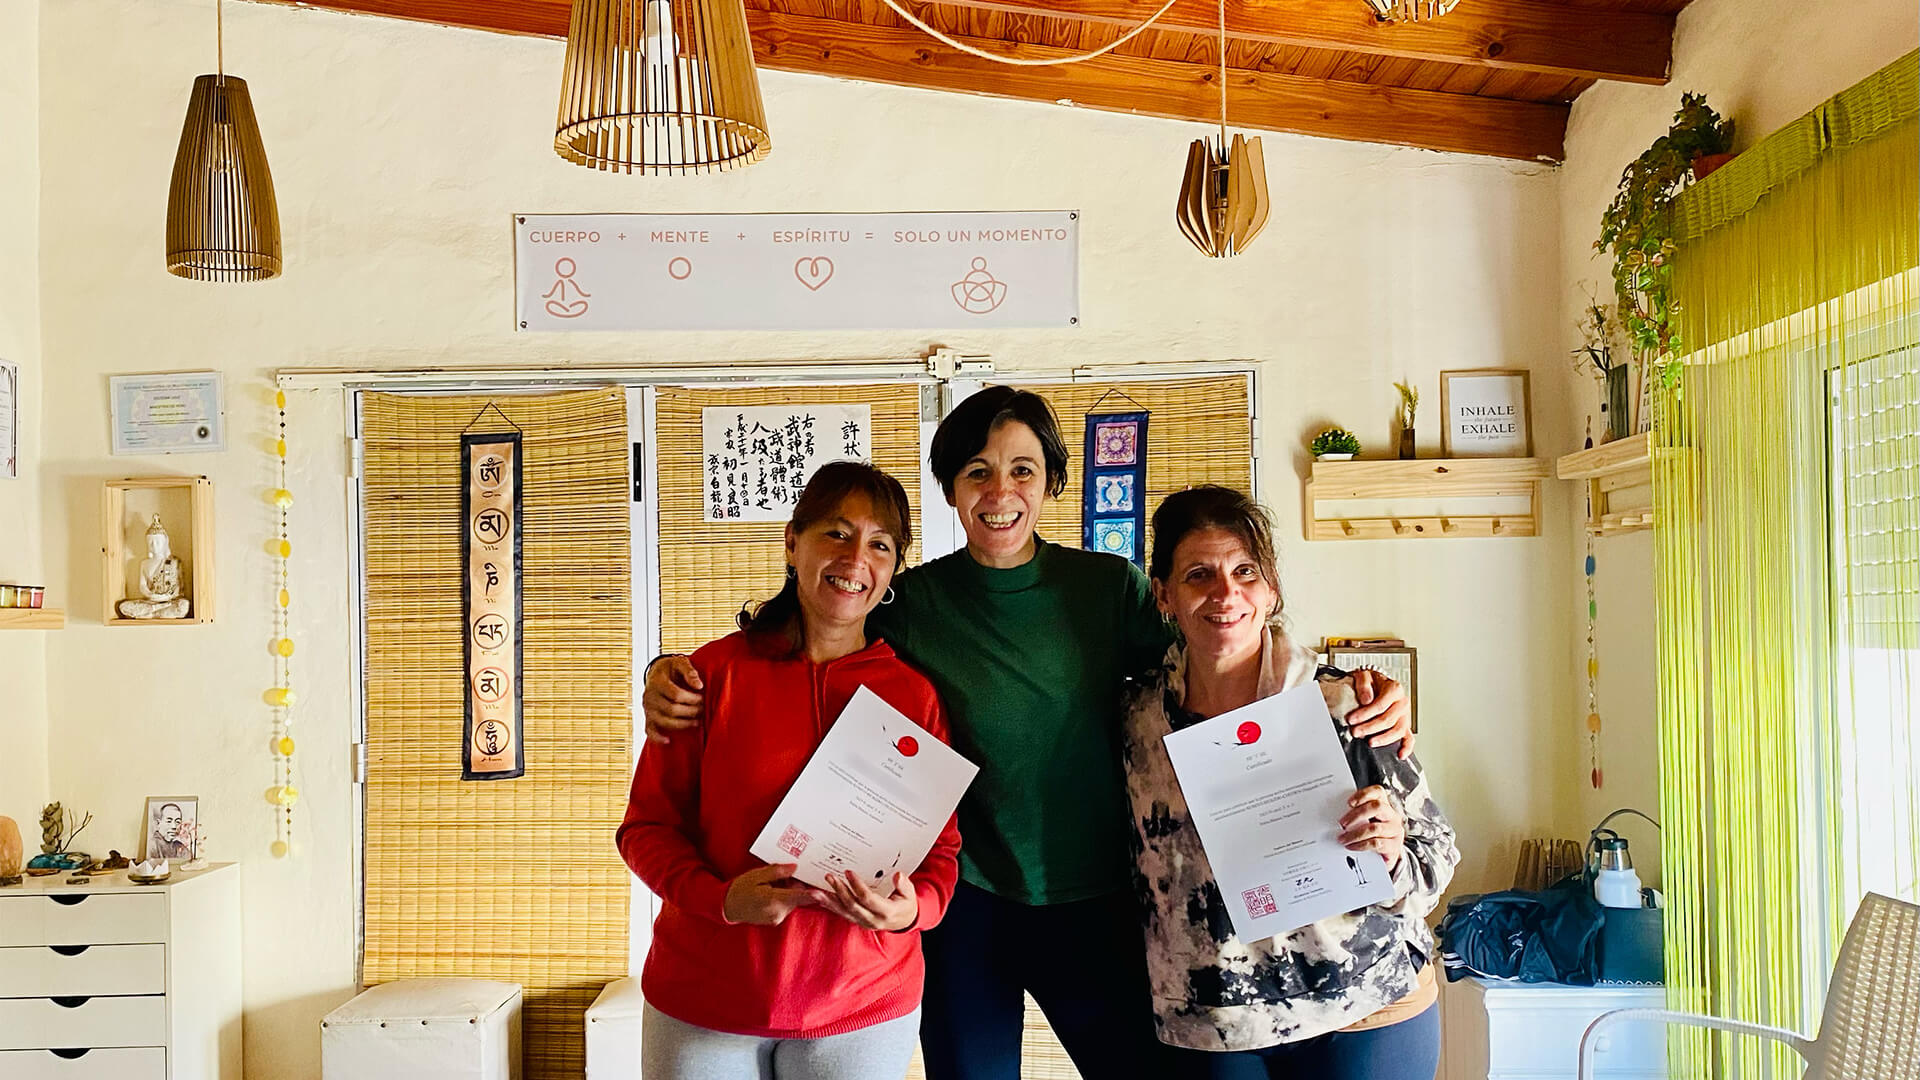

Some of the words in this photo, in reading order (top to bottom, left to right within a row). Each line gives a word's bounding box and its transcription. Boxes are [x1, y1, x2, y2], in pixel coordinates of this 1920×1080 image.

[529, 231, 601, 243] CUERPO
[650, 231, 710, 243] MENTE
[773, 228, 850, 243] ESPÍRITU
[894, 231, 940, 243] SOLO
[947, 231, 971, 242] UN
[978, 229, 1067, 241] MOMENTO
[1461, 406, 1515, 416] INHALE
[1461, 424, 1516, 434] EXHALE
